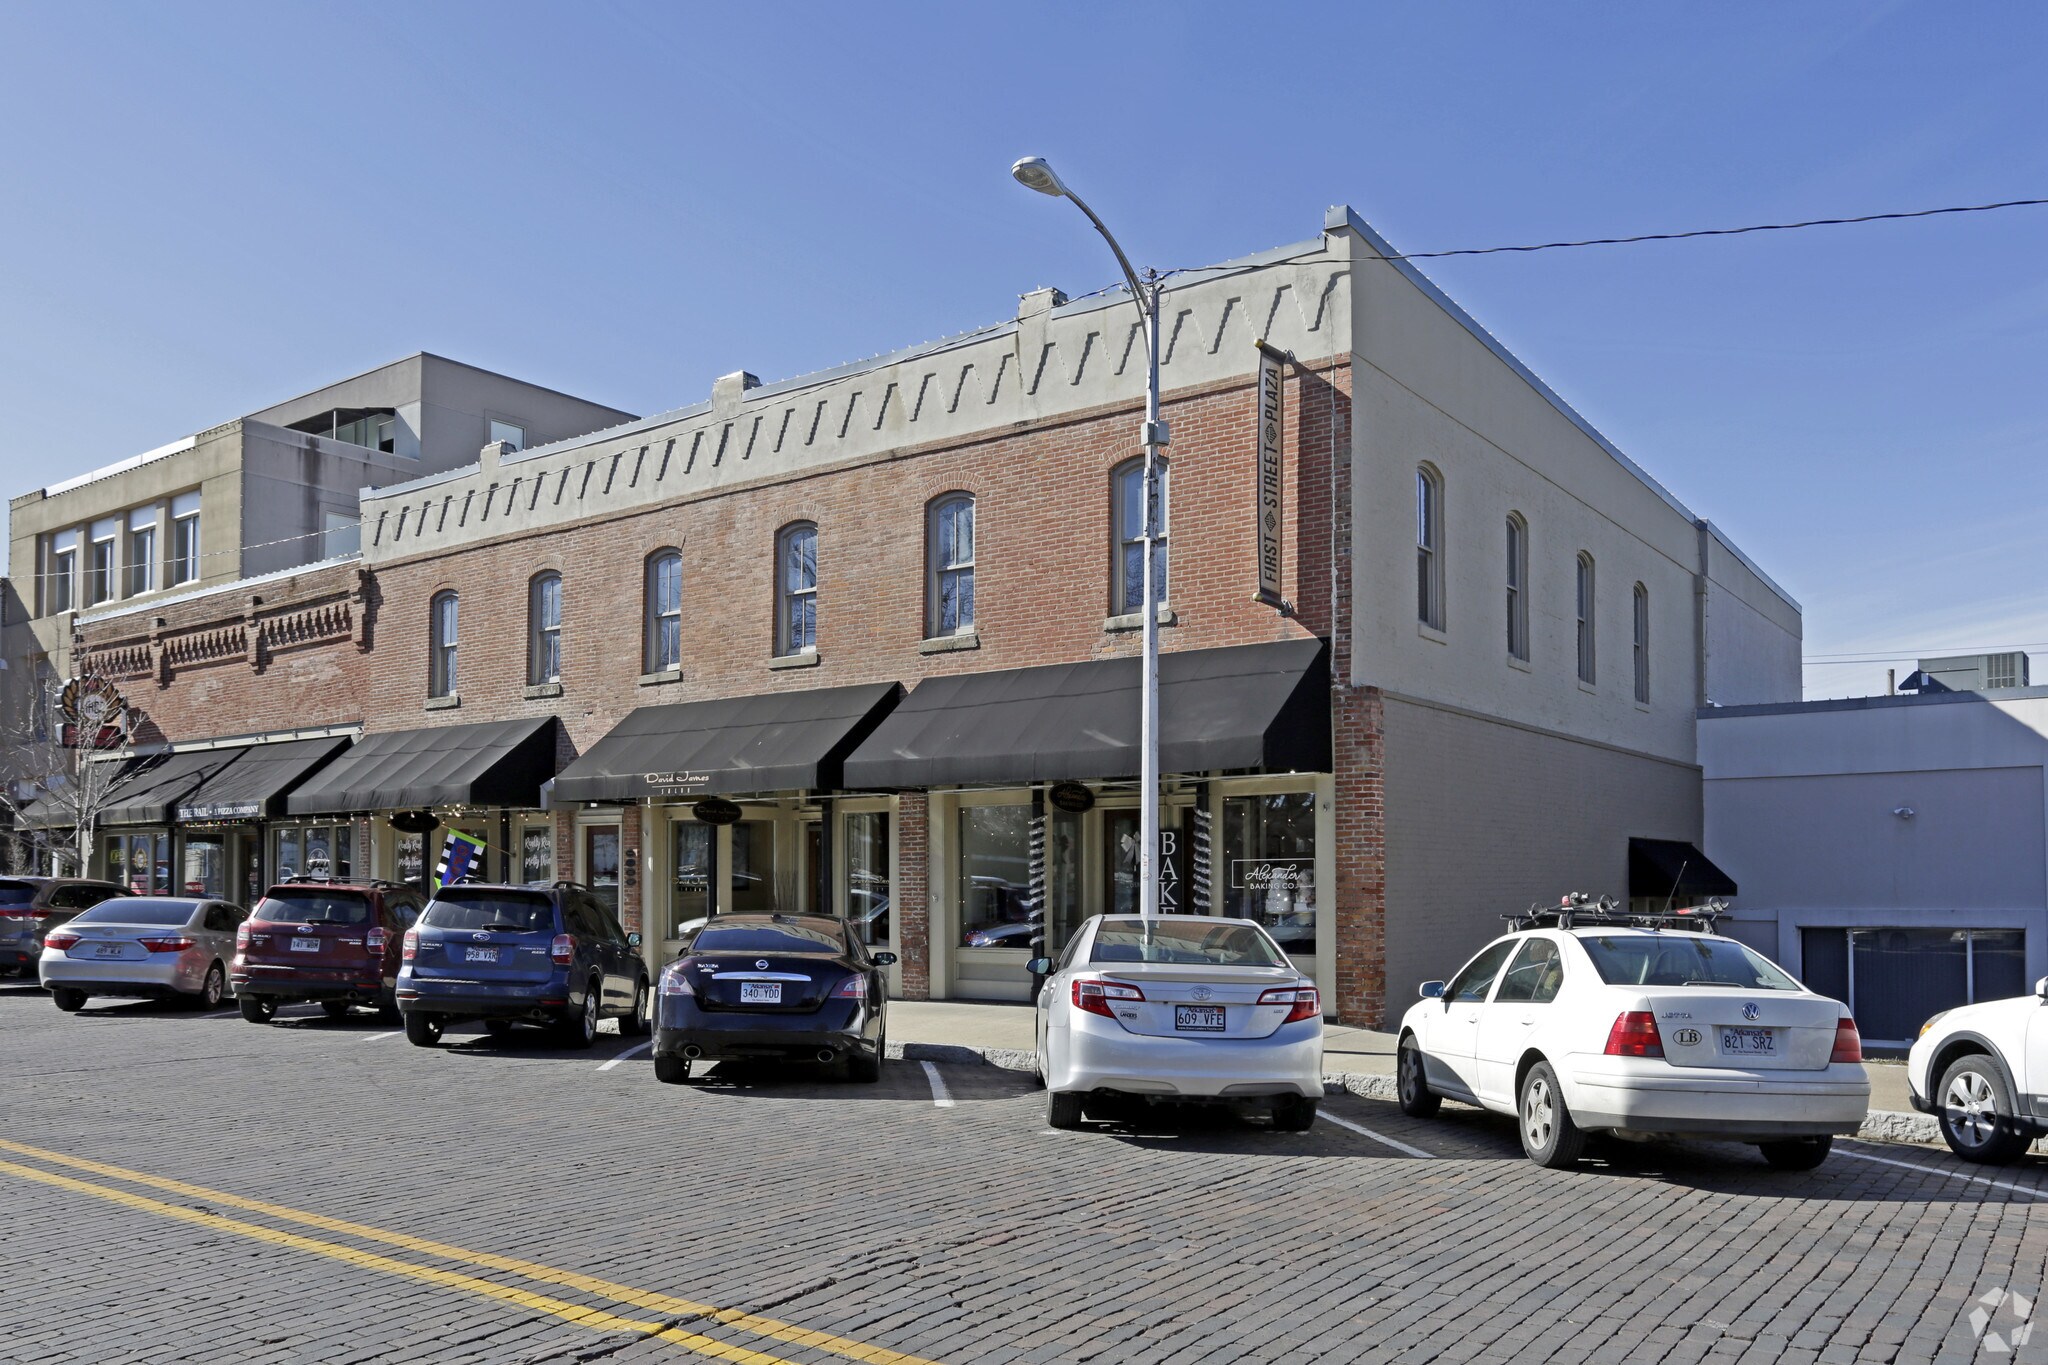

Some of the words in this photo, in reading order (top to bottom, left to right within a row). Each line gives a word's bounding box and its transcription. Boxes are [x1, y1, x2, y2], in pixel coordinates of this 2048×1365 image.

[1264, 368, 1279, 422] PLAZA
[1263, 443, 1278, 508] STREET
[1263, 533, 1278, 583] FIRST
[643, 773, 674, 783] David
[676, 771, 709, 782] James
[179, 808, 193, 818] THE
[194, 807, 208, 817] RAIL
[218, 807, 233, 815] PIZZA
[233, 805, 259, 814] COMPANY
[1245, 863, 1301, 882] Alexander
[466, 950, 480, 959] 958
[742, 988, 759, 998] 340
[764, 988, 780, 999] YDD
[1178, 1014, 1197, 1025] 609
[1203, 1014, 1223, 1026] VFE
[1679, 1033, 1698, 1043] LB
[1733, 1028, 1763, 1036] Arkansas
[1724, 1035, 1744, 1049] 821
[1753, 1036, 1774, 1050] SRZ
